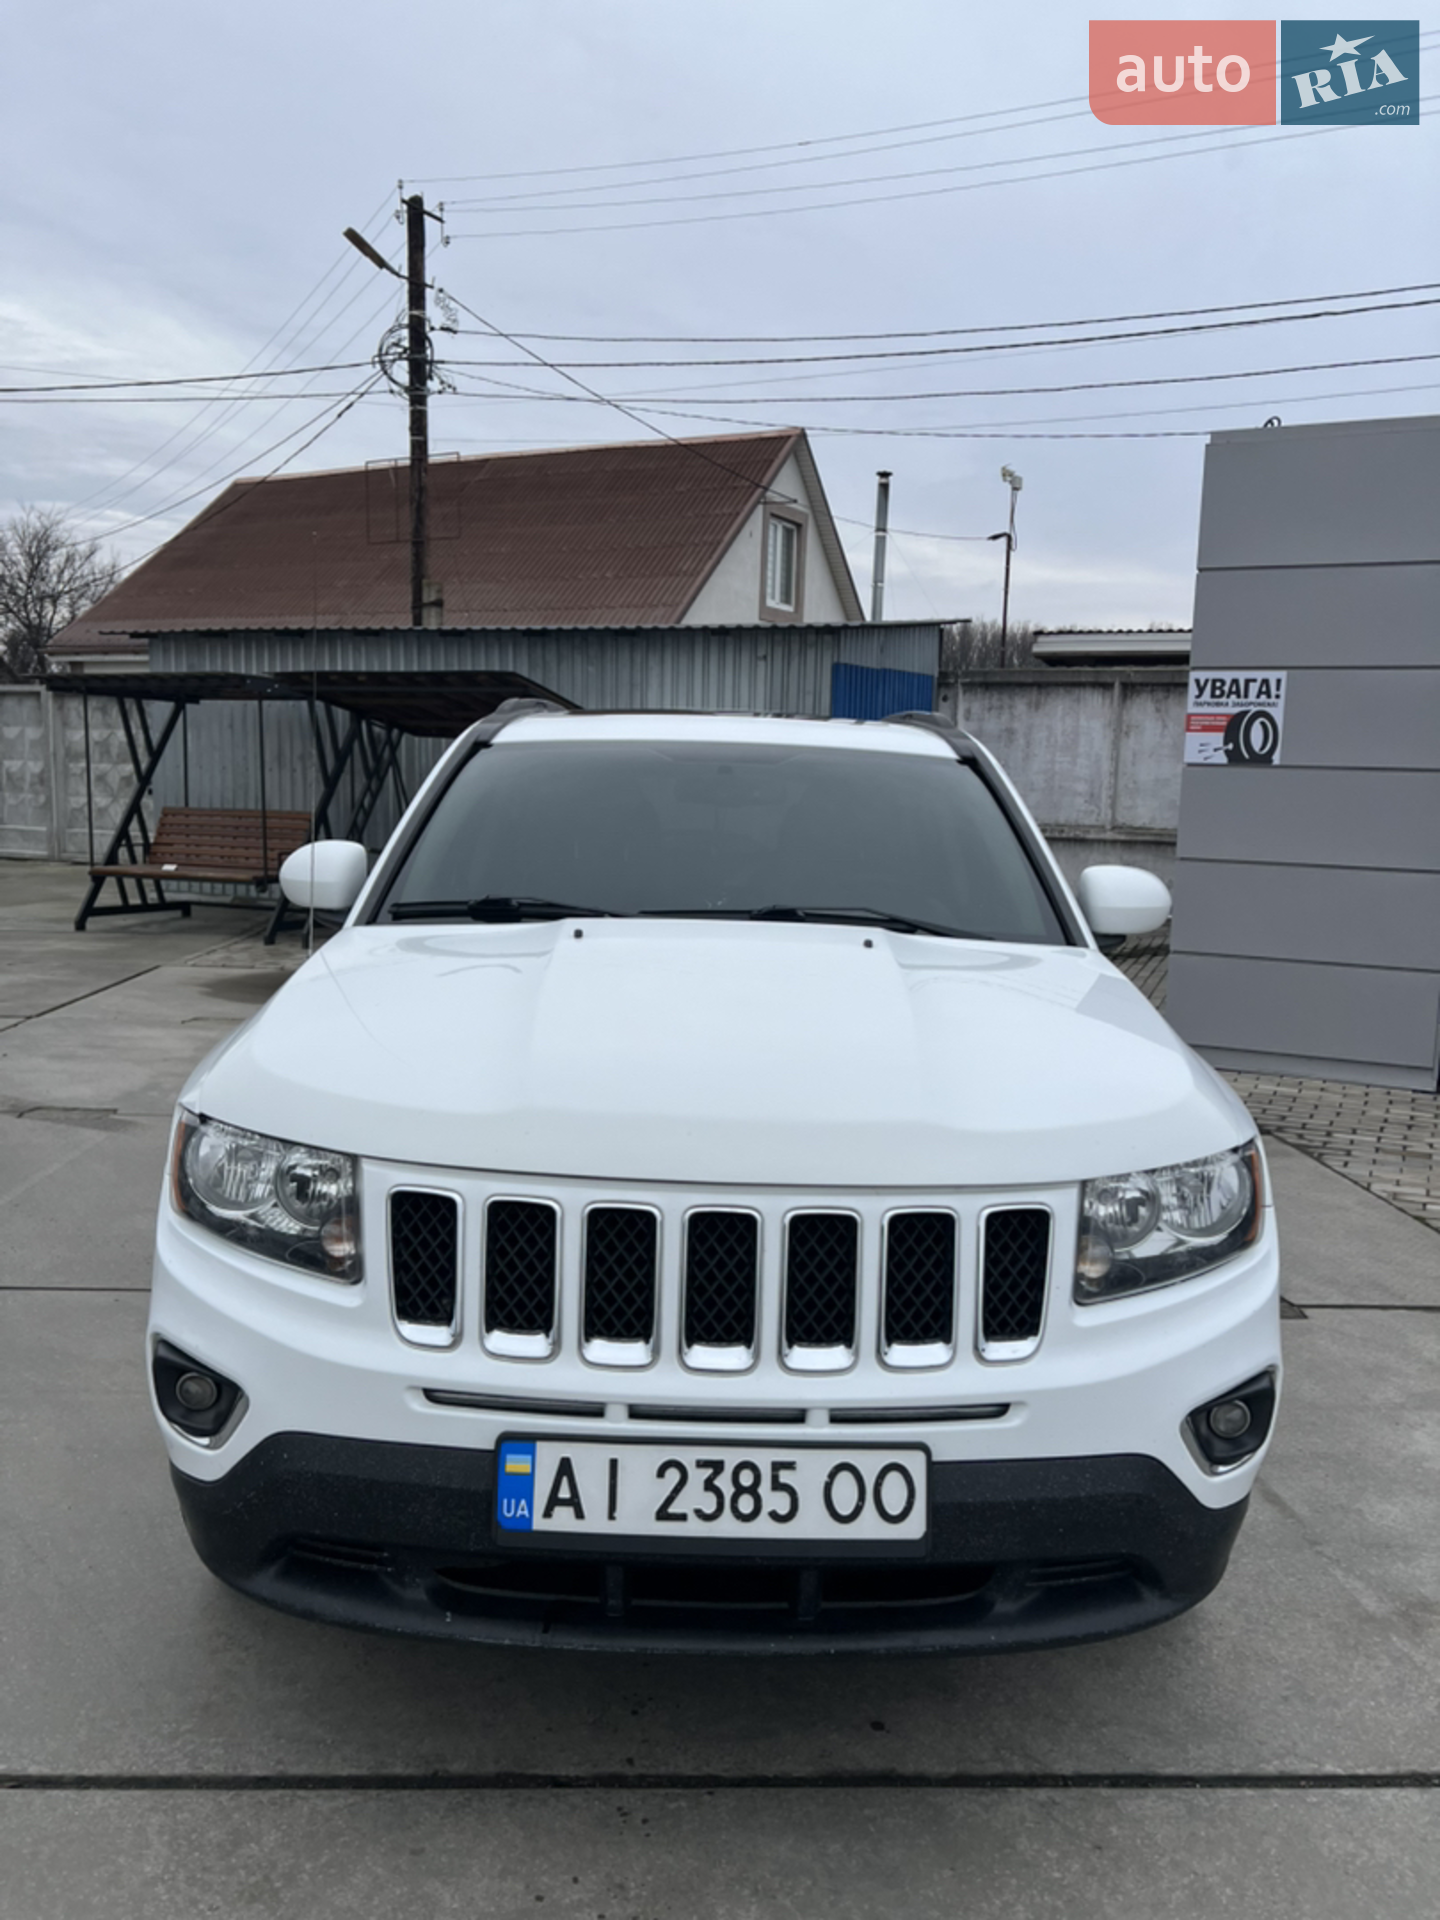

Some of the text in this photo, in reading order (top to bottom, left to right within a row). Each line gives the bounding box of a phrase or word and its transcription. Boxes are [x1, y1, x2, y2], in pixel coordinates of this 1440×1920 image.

[1194, 678, 1281, 699] УВАГА!
[542, 1456, 618, 1520] AI
[655, 1459, 799, 1524] 2385
[502, 1498, 530, 1518] UA
